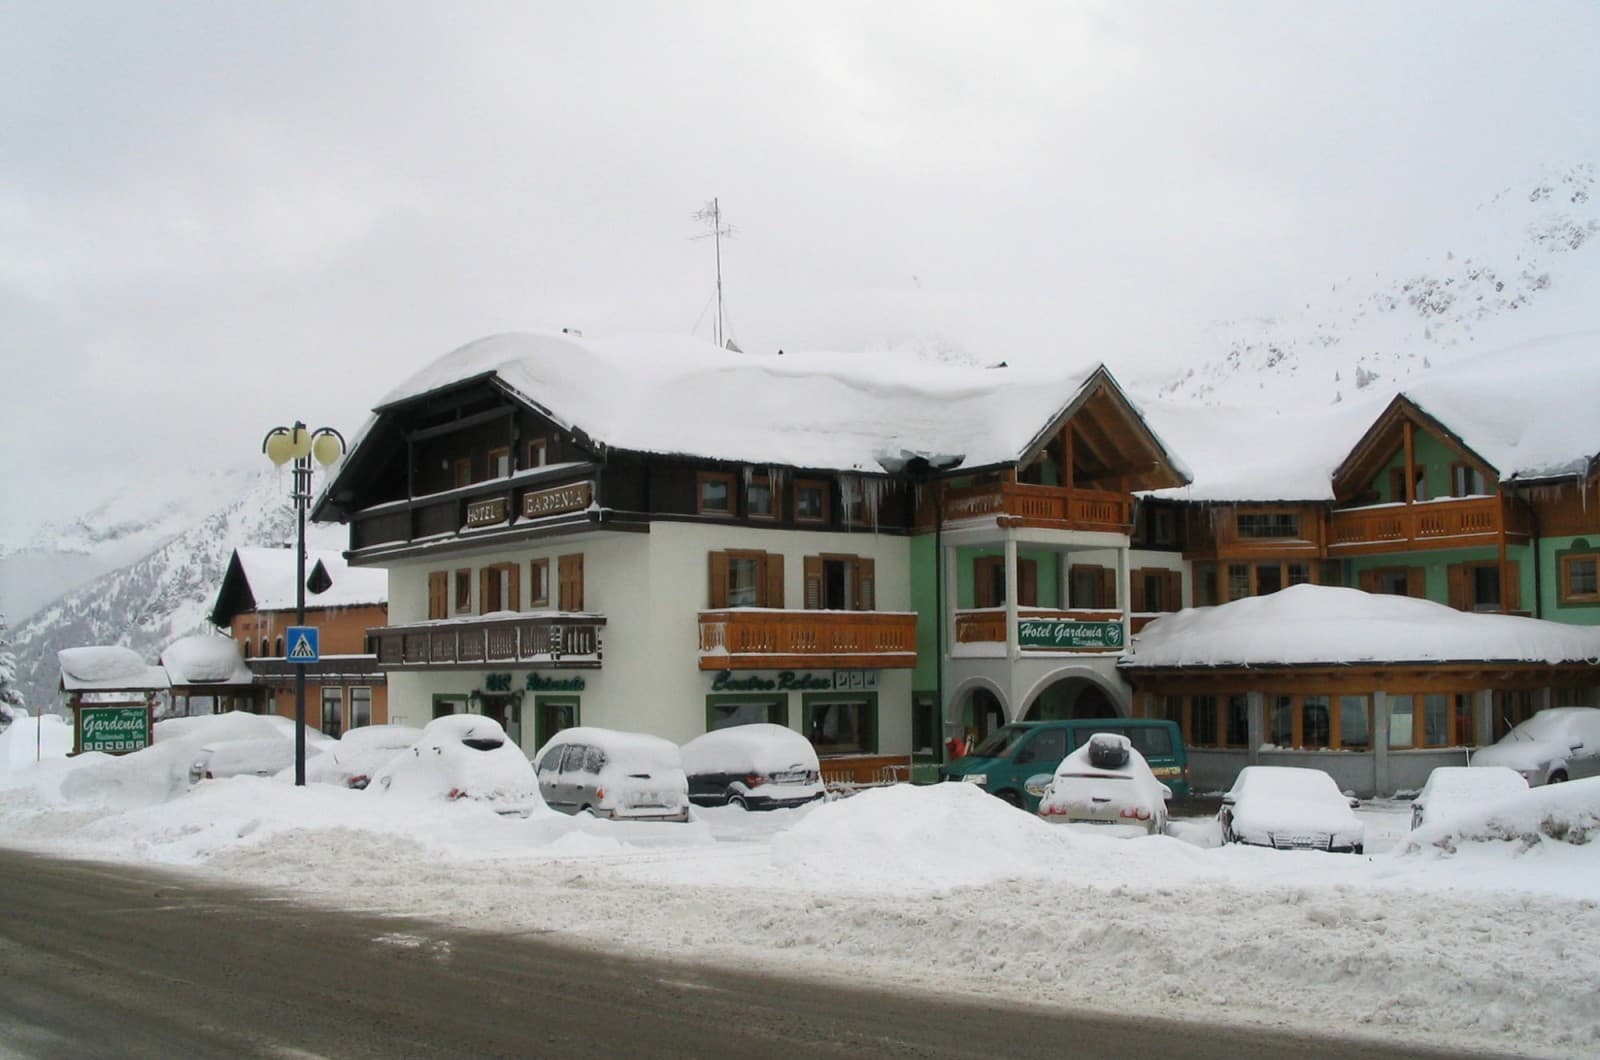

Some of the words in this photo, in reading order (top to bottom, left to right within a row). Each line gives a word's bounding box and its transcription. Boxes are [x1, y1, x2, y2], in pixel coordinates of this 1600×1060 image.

[467, 504, 496, 522] HOTEL
[527, 488, 584, 513] GARDENIA
[1020, 623, 1052, 638] Hotel
[1054, 624, 1102, 643] Gardenia
[83, 713, 145, 738] Gardenia
